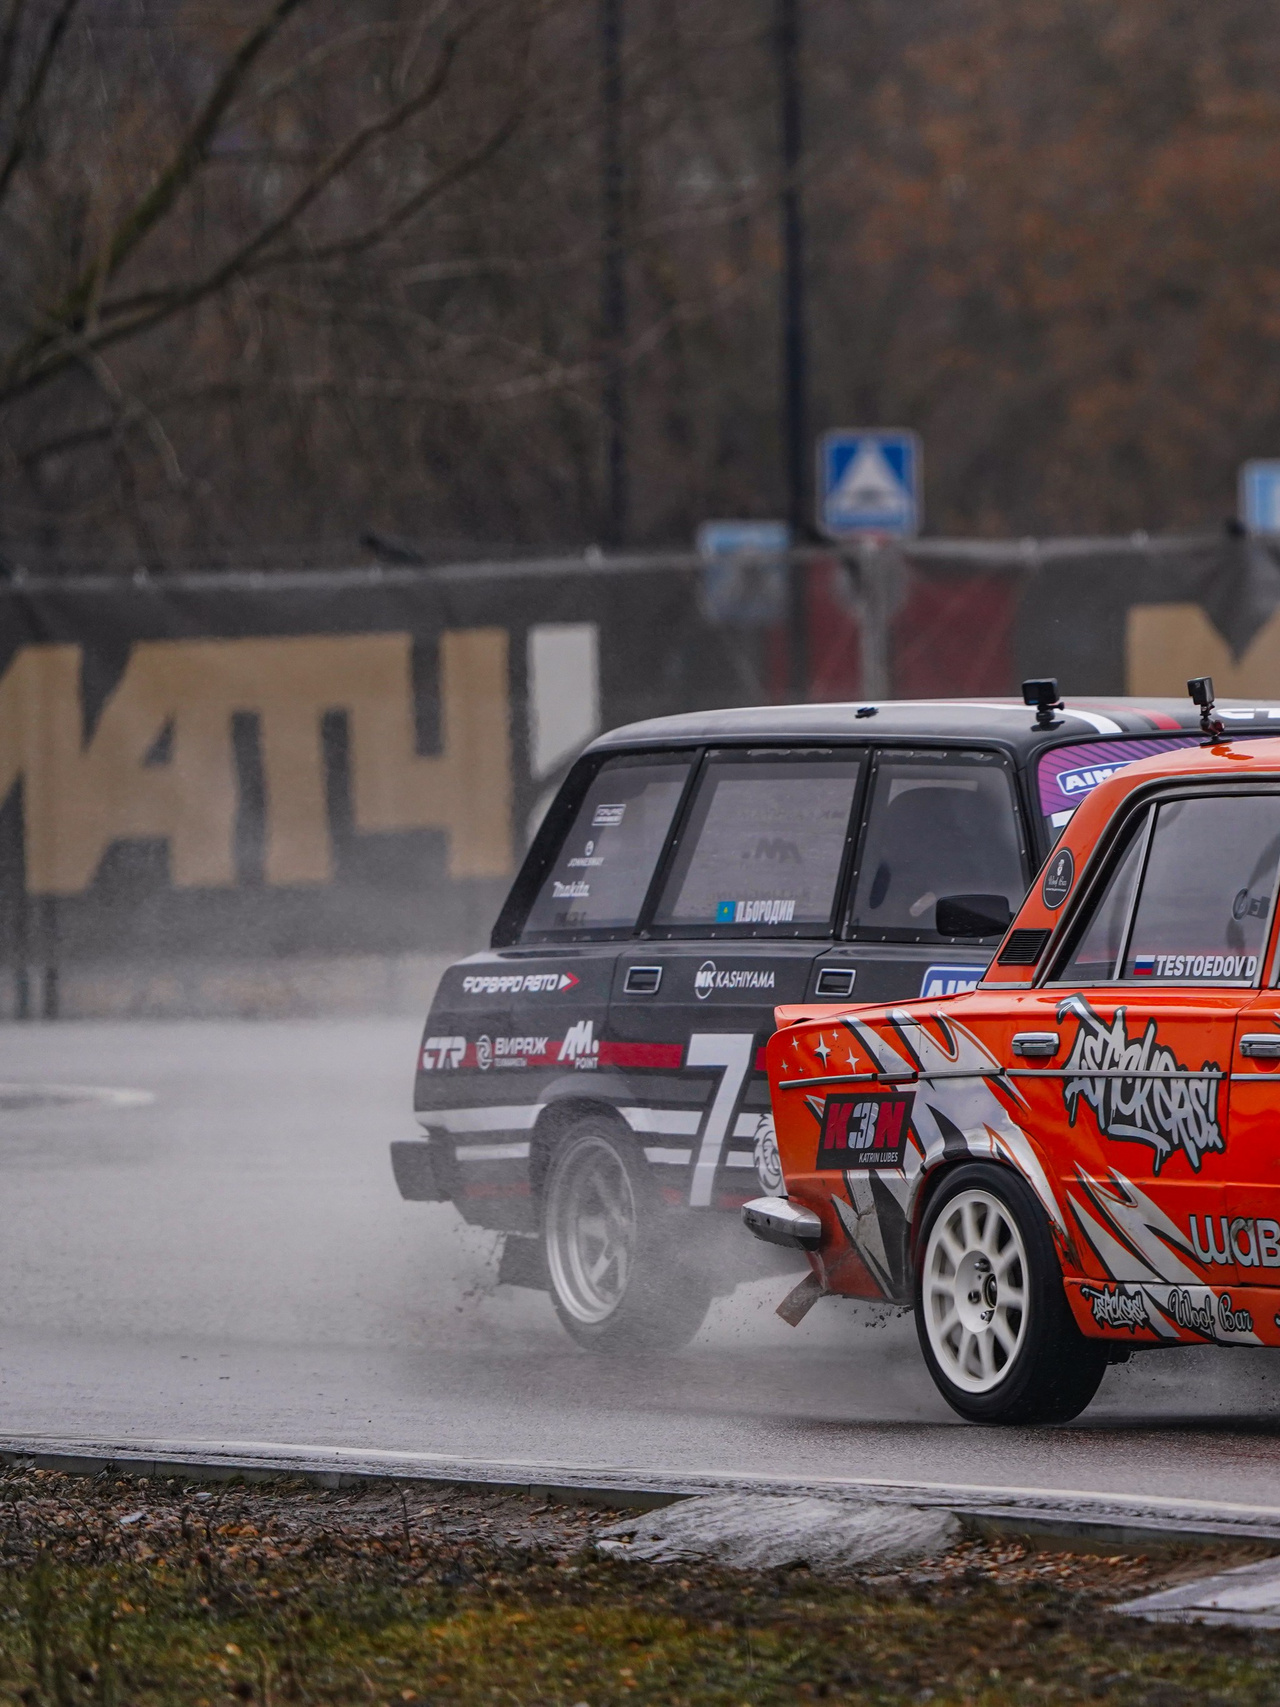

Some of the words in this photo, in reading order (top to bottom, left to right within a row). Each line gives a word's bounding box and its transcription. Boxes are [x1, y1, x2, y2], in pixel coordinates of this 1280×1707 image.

[1066, 767, 1123, 791] AIM
[552, 880, 590, 897] Makita
[735, 899, 796, 924] П.БОРОДИН
[1156, 954, 1247, 977] TESTOEDOV
[1245, 955, 1257, 977] D
[714, 970, 775, 988] KASHIYAMA
[422, 1036, 467, 1069] CTR
[494, 1036, 549, 1056] ВИРАЖ
[574, 1057, 599, 1069] POINT
[686, 1033, 754, 1207] 7
[858, 1151, 880, 1164] KATRIN
[880, 1151, 899, 1164] LUBES
[1167, 1289, 1216, 1337] Woof
[1217, 1293, 1253, 1332] Bar
